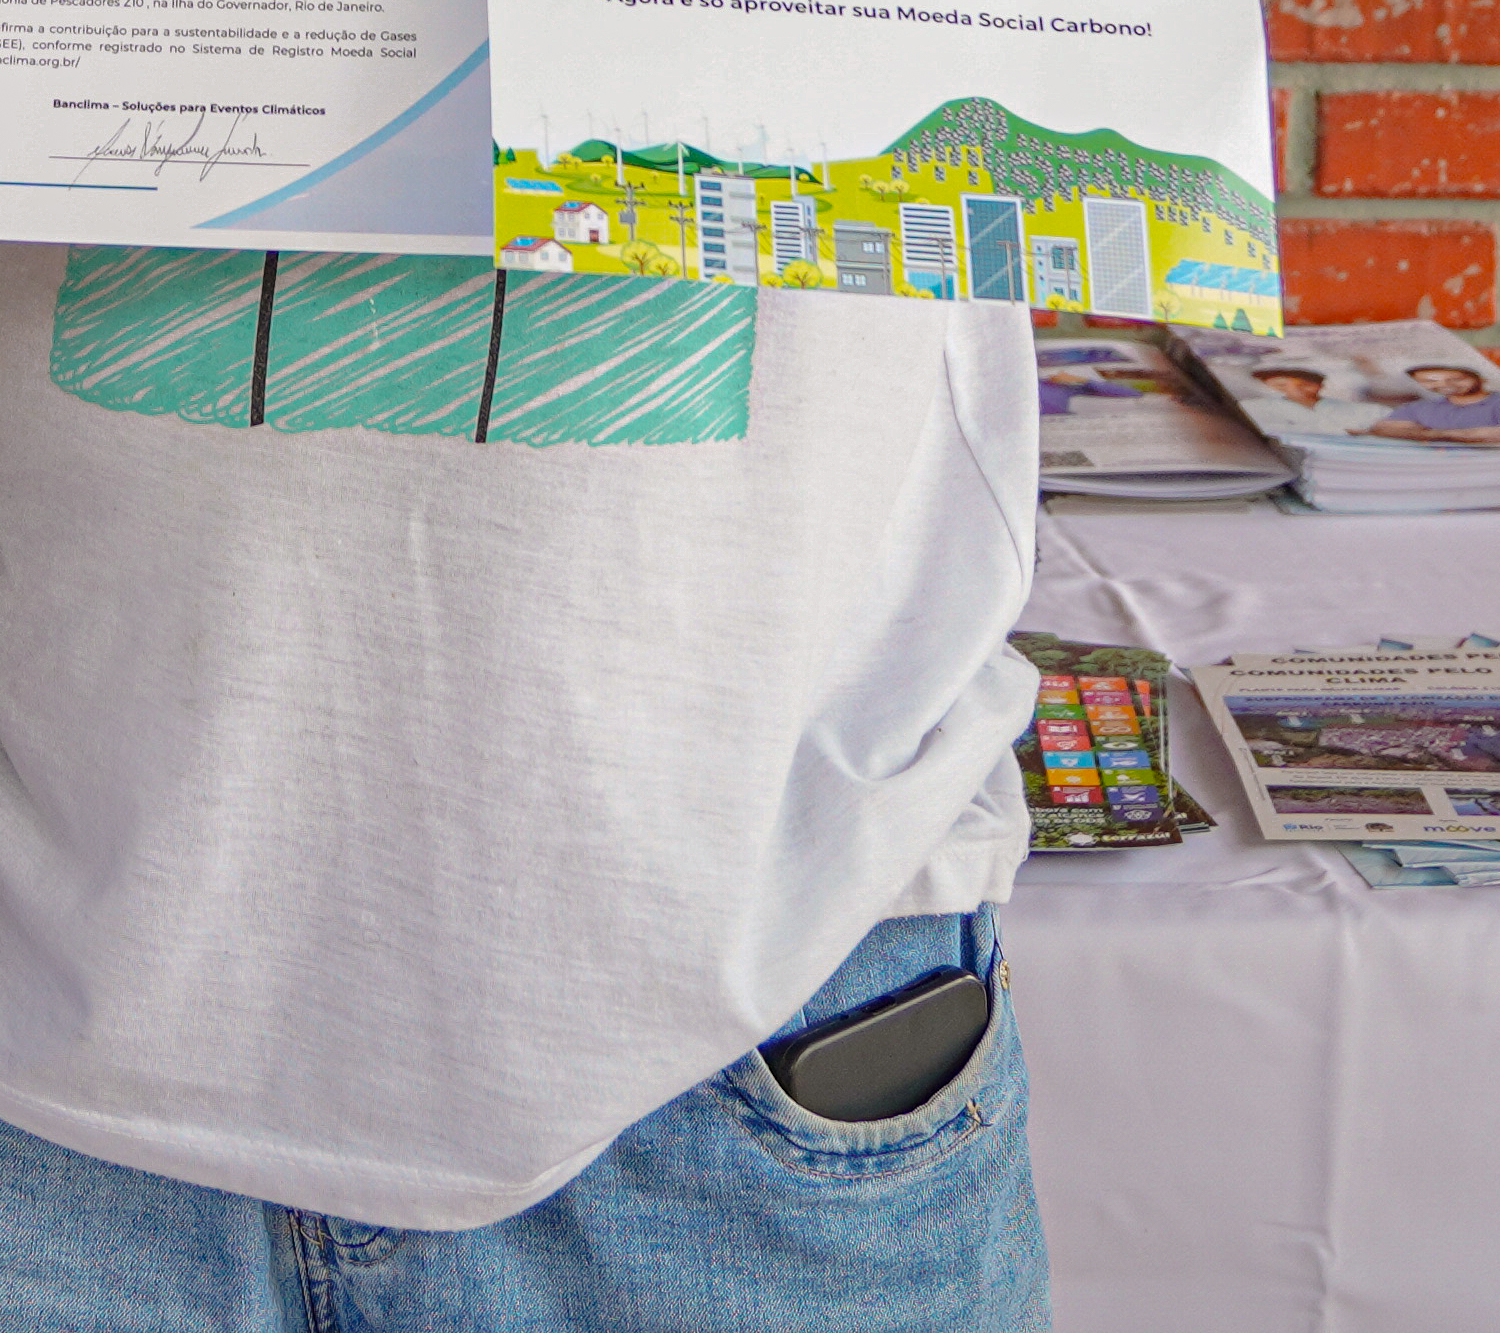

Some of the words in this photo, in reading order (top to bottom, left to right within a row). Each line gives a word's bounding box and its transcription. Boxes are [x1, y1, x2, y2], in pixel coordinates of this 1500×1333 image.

[852, 5, 891, 20] sua
[896, 5, 973, 27] Moeda
[978, 11, 1044, 32] Social
[1050, 16, 1152, 38] Carbono!
[53, 98, 110, 111] Banclima
[121, 99, 177, 115] Soluções
[179, 103, 207, 118] para
[210, 102, 259, 119] Eventos
[261, 103, 326, 117] Climáticos
[1270, 653, 1459, 664] COMUNIDADES
[1230, 667, 1420, 677] COMUNIDADES
[1426, 666, 1494, 675] PELO
[1324, 676, 1408, 685] CLIMA
[1298, 823, 1324, 831] Rio
[1422, 823, 1498, 833] moove
